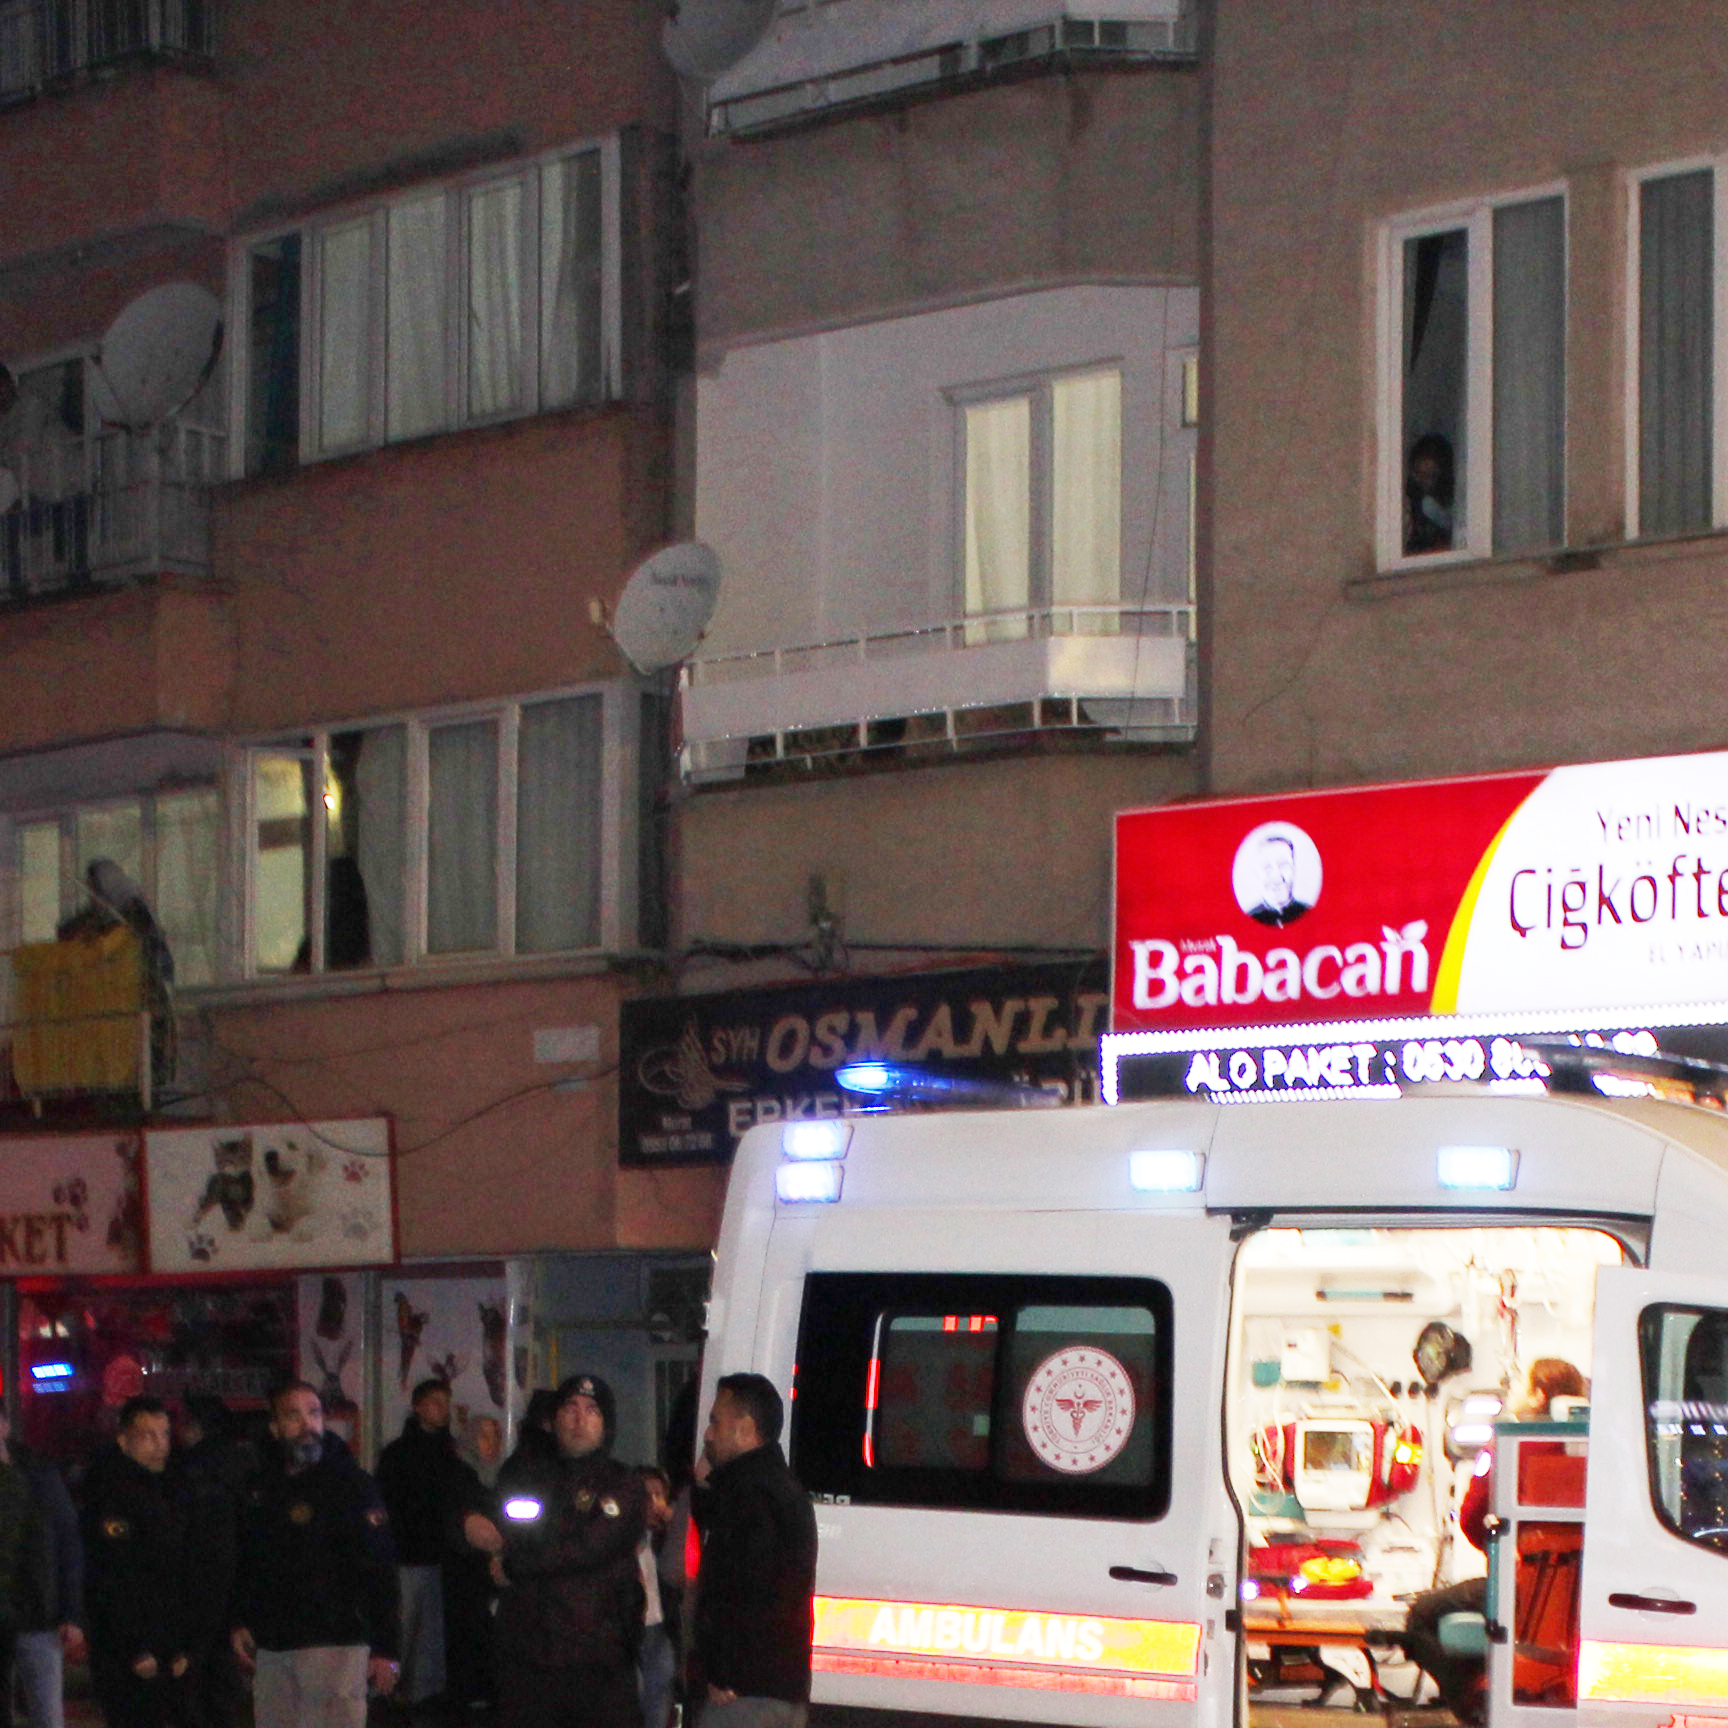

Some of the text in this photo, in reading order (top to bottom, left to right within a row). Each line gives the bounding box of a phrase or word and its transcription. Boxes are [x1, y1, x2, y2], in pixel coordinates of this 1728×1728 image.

[1597, 802, 1661, 842] Yeni
[1129, 930, 1430, 1010] Babacan
[766, 993, 1108, 1074] OSMANLI
[1262, 1042, 1378, 1090] PAKET
[868, 1606, 1104, 1661] AMBULANS
